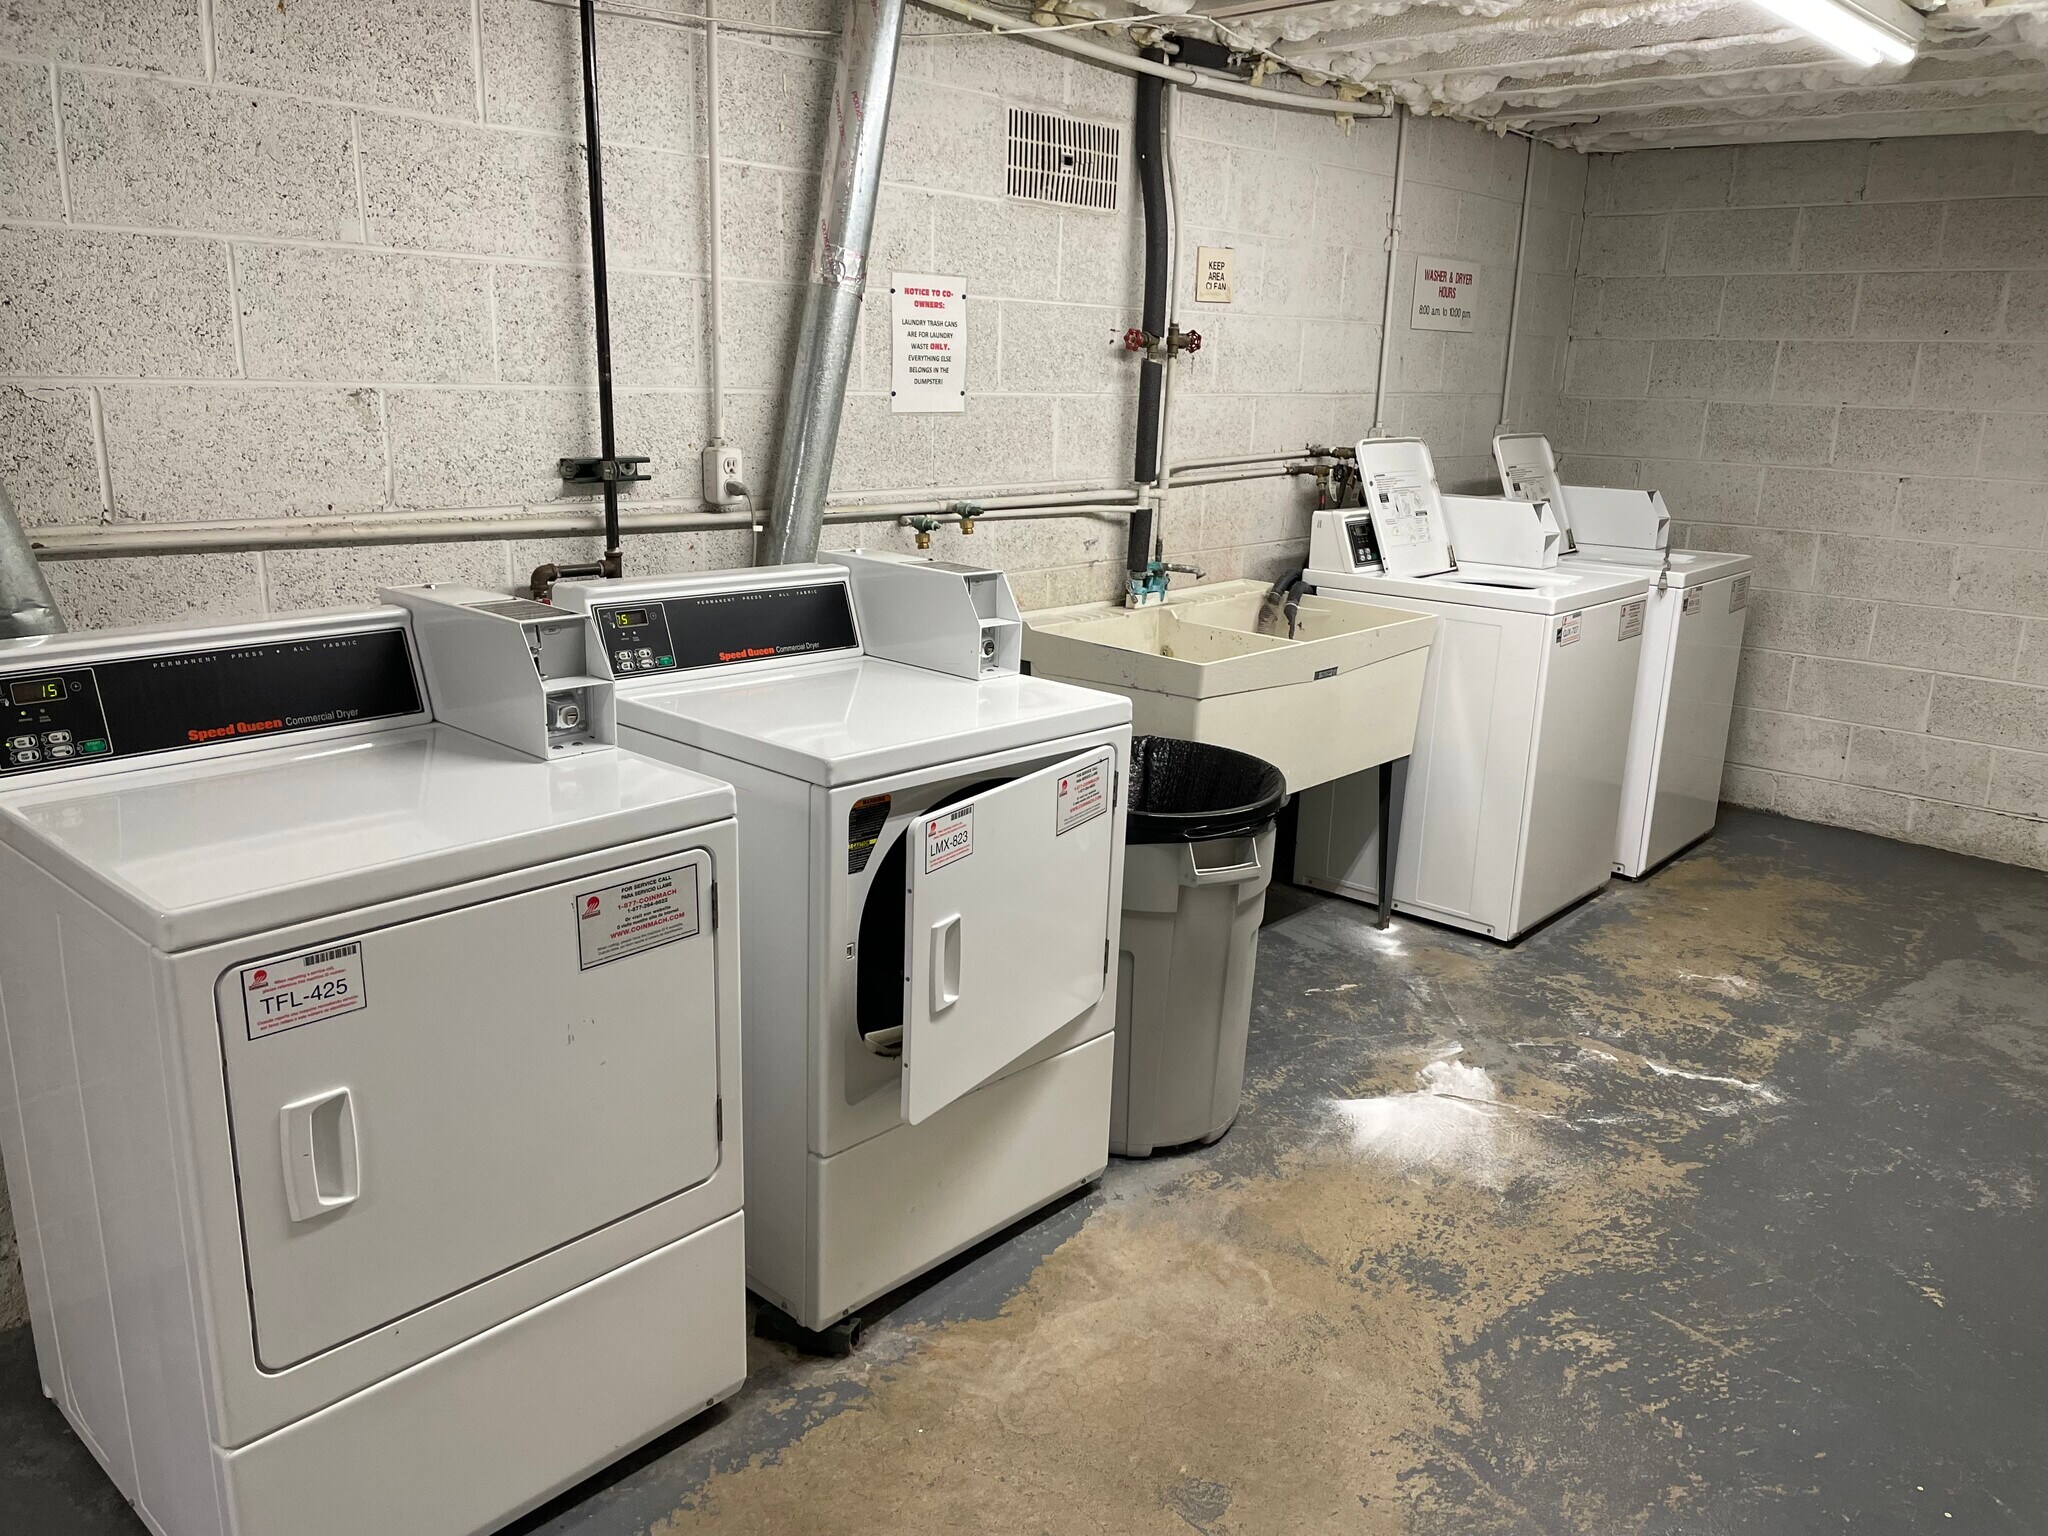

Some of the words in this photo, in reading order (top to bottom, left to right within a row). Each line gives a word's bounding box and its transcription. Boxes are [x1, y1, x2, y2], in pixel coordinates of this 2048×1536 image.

[1209, 261, 1225, 270] KEEP
[1208, 272, 1225, 281] AREA
[1425, 269, 1447, 282] WASHER
[1449, 272, 1453, 283] &
[1456, 273, 1472, 285] DRYER
[904, 287, 930, 296] NOTICE
[932, 289, 940, 297] TO
[942, 290, 954, 298] CO-
[1439, 286, 1456, 299] HOURS
[914, 300, 945, 309] OWNERS:
[902, 318, 926, 326] LAUNDRY
[944, 320, 958, 328] CANS
[907, 330, 918, 338] ARE
[908, 354, 940, 362] EVERYTHING
[697, 597, 735, 605] PERMANENT
[152, 655, 218, 669] PERMANENT
[230, 651, 264, 660] PRESS
[322, 639, 358, 649] FABRIC
[719, 649, 747, 661] Speed
[747, 647, 775, 657] Queen
[775, 643, 805, 653] Commercial
[805, 642, 820, 650] Dryer
[42, 684, 58, 698] 15
[187, 724, 235, 742] Speed
[236, 719, 283, 733] Queen
[285, 712, 335, 727] Commercial
[336, 708, 359, 720] Dryer
[931, 830, 968, 857] LMX-823
[634, 879, 657, 890] SERVICE
[635, 887, 656, 896] SERVICIO
[657, 882, 672, 890] LLAME
[618, 889, 677, 910] 1-877-COINMACH
[610, 912, 685, 939] WWW.COINMACH.COM
[259, 978, 348, 1014] TFL-425
